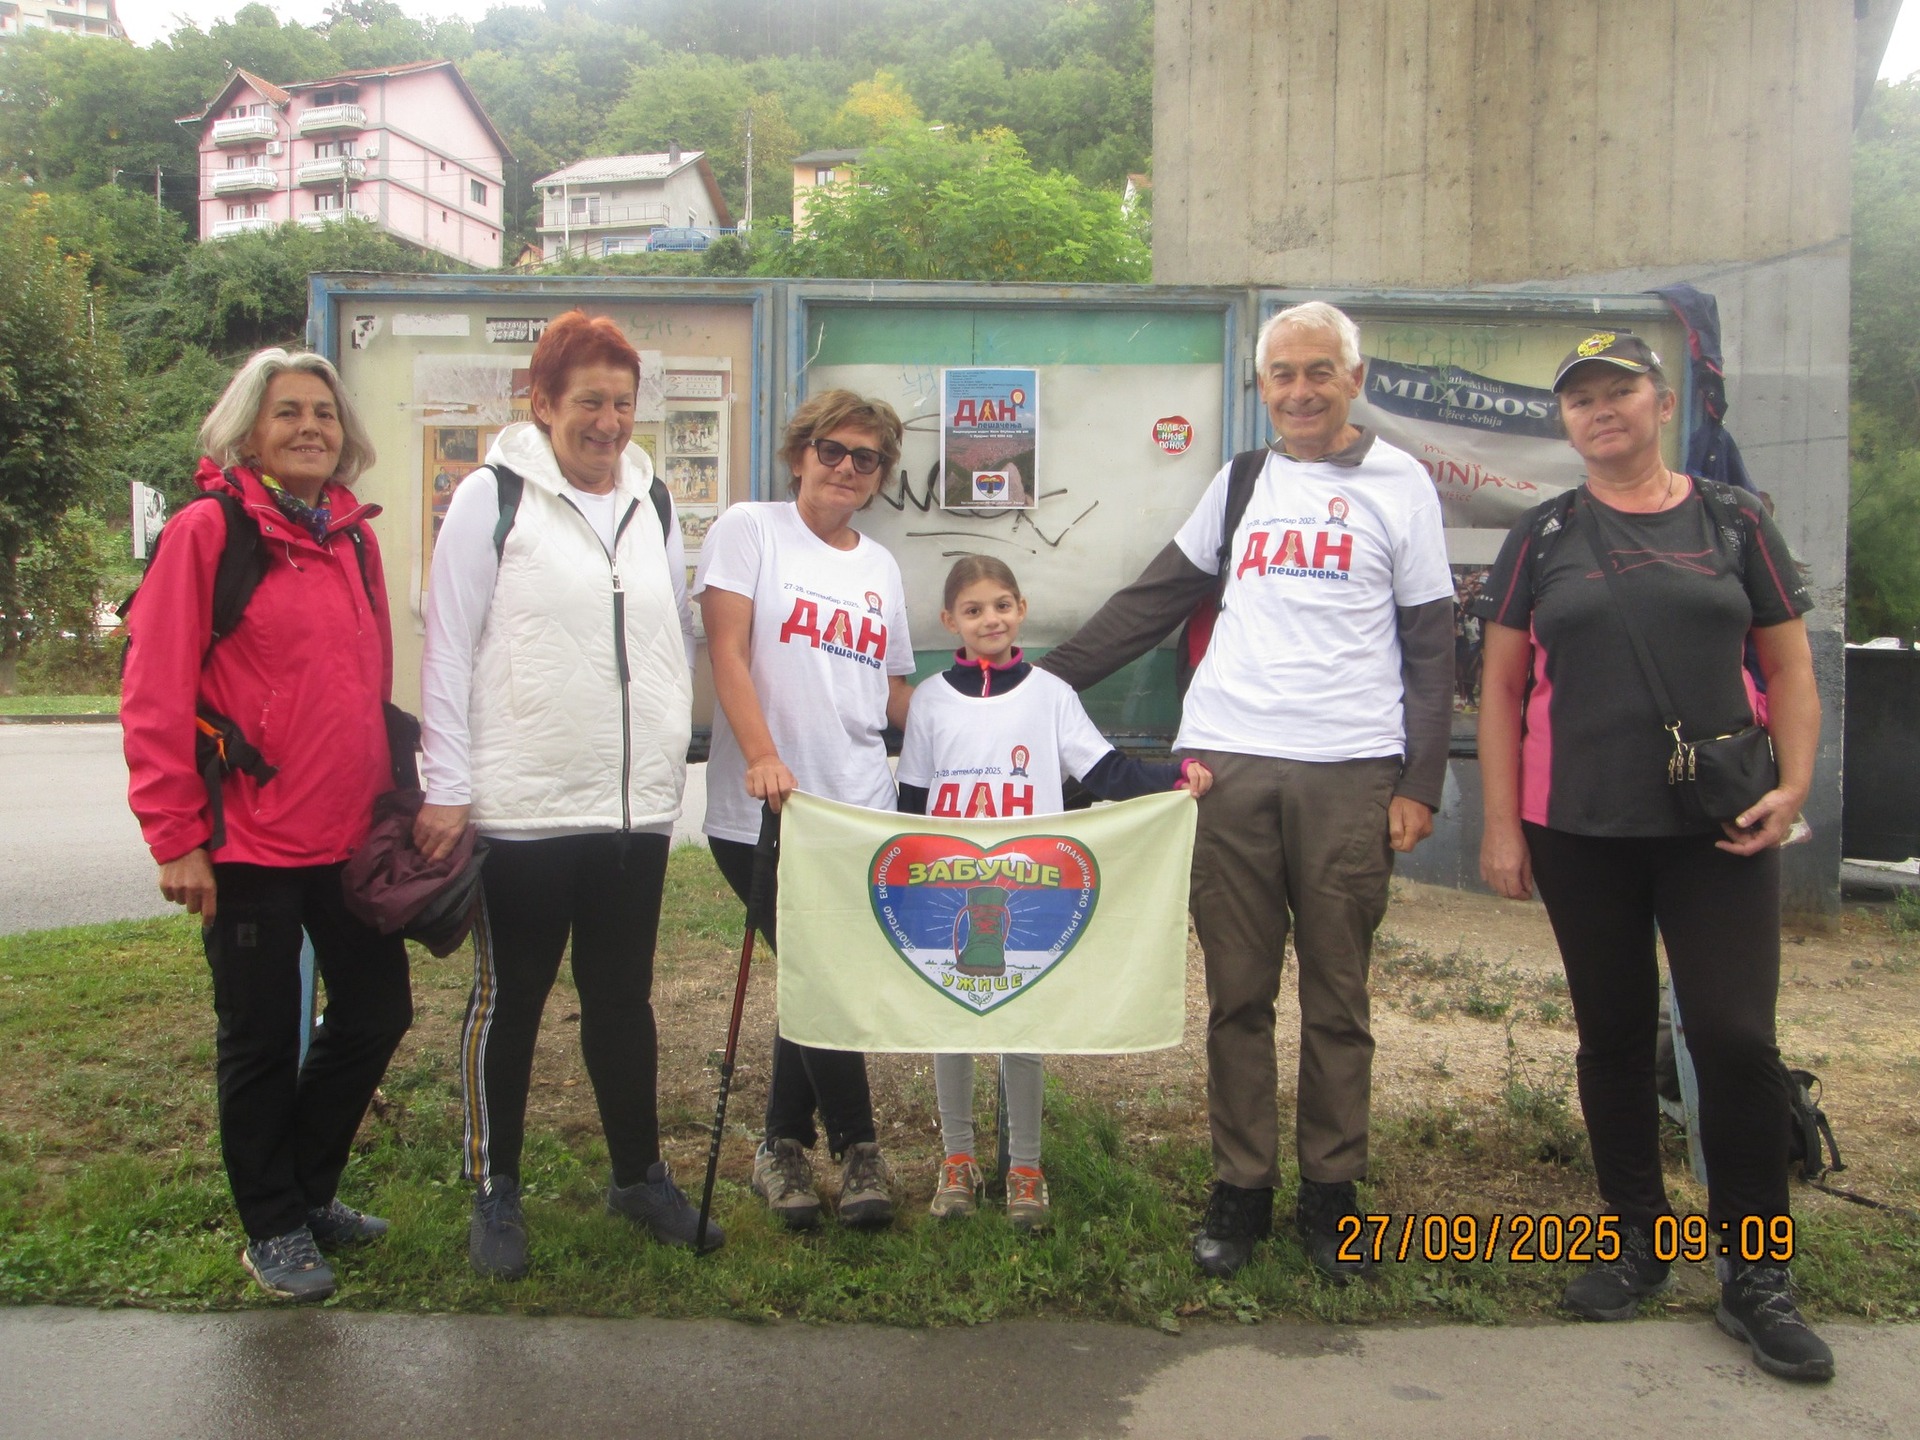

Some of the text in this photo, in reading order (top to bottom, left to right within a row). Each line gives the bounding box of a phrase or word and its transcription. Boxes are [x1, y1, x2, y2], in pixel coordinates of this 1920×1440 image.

[953, 399, 1017, 427] ДАН
[1237, 530, 1353, 581] ДАН
[1267, 566, 1349, 581] пешачења
[779, 597, 887, 661] ДАН
[931, 782, 1034, 818] ДАН
[908, 858, 1062, 887] ЗАБУЧЈЕ
[878, 846, 917, 954] СПОРТСКО ЕКОЛОШКО
[1048, 841, 1092, 955] ПЛАНИНАРСКО ДРУШТВО
[941, 972, 1023, 992] УЖИЦЕ
